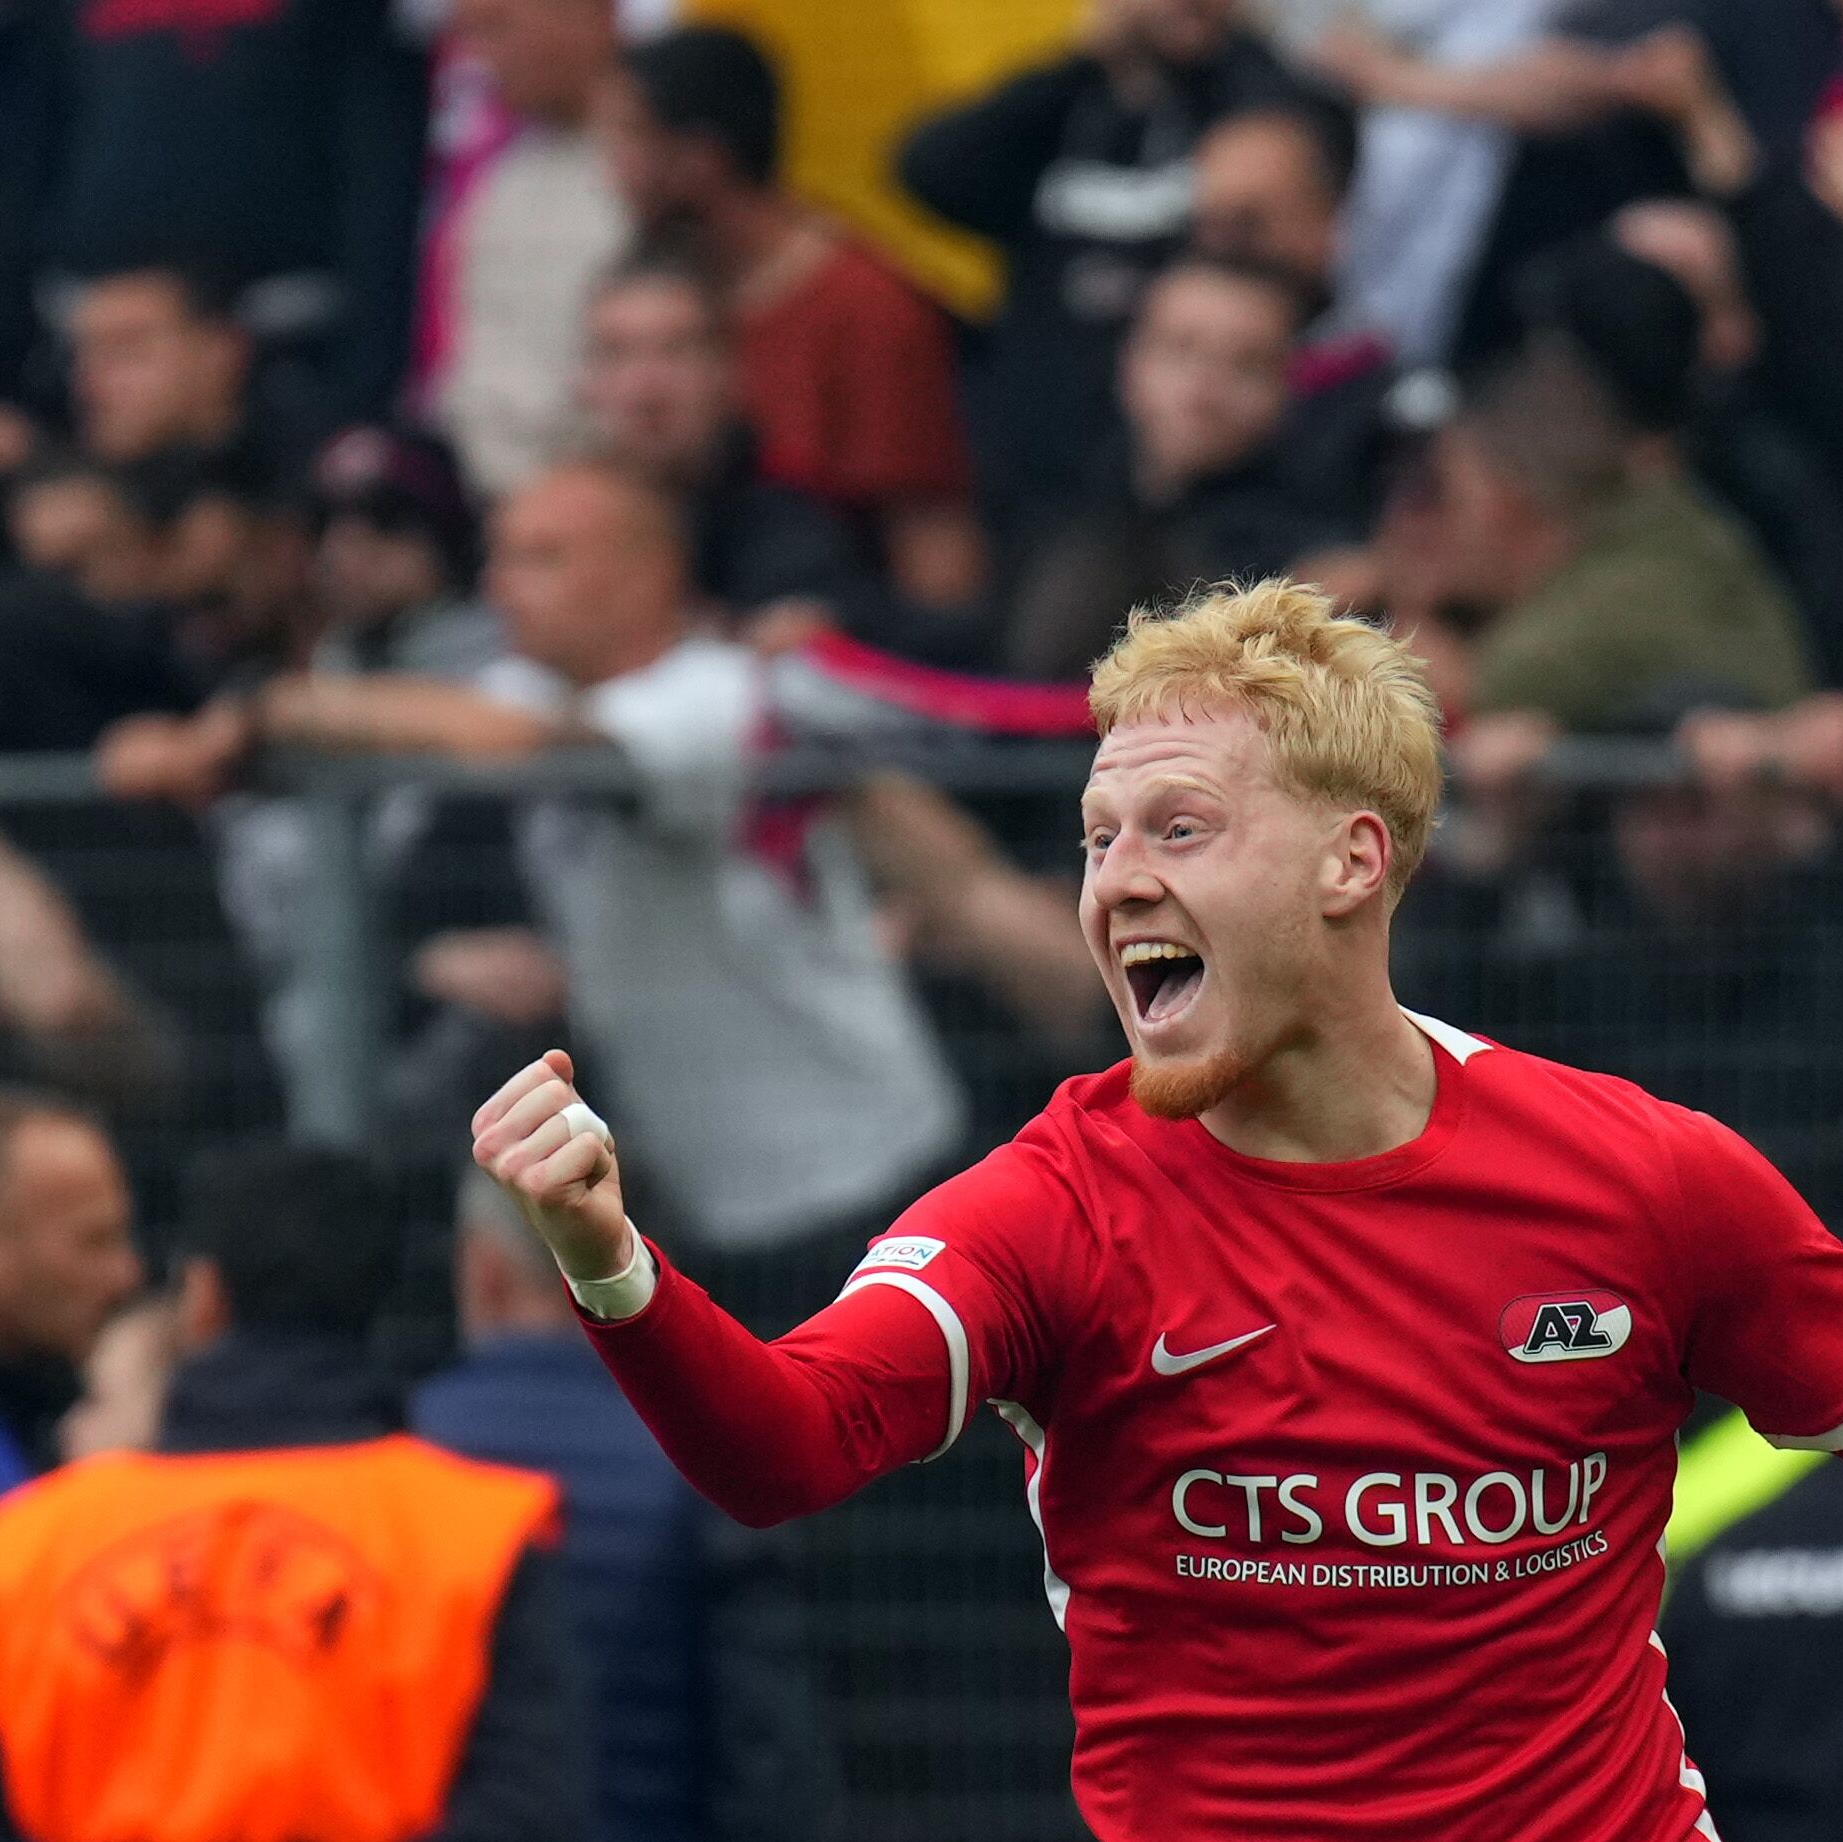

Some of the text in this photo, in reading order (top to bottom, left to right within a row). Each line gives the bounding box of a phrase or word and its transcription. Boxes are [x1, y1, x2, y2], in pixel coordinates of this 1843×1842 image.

[1523, 1301, 1612, 1354] AZ
[1172, 1451, 1607, 1546] CTS GROUP
[1176, 1530, 1608, 1588] EUROPEAN DISTRIBUTION & LOGISTICS
